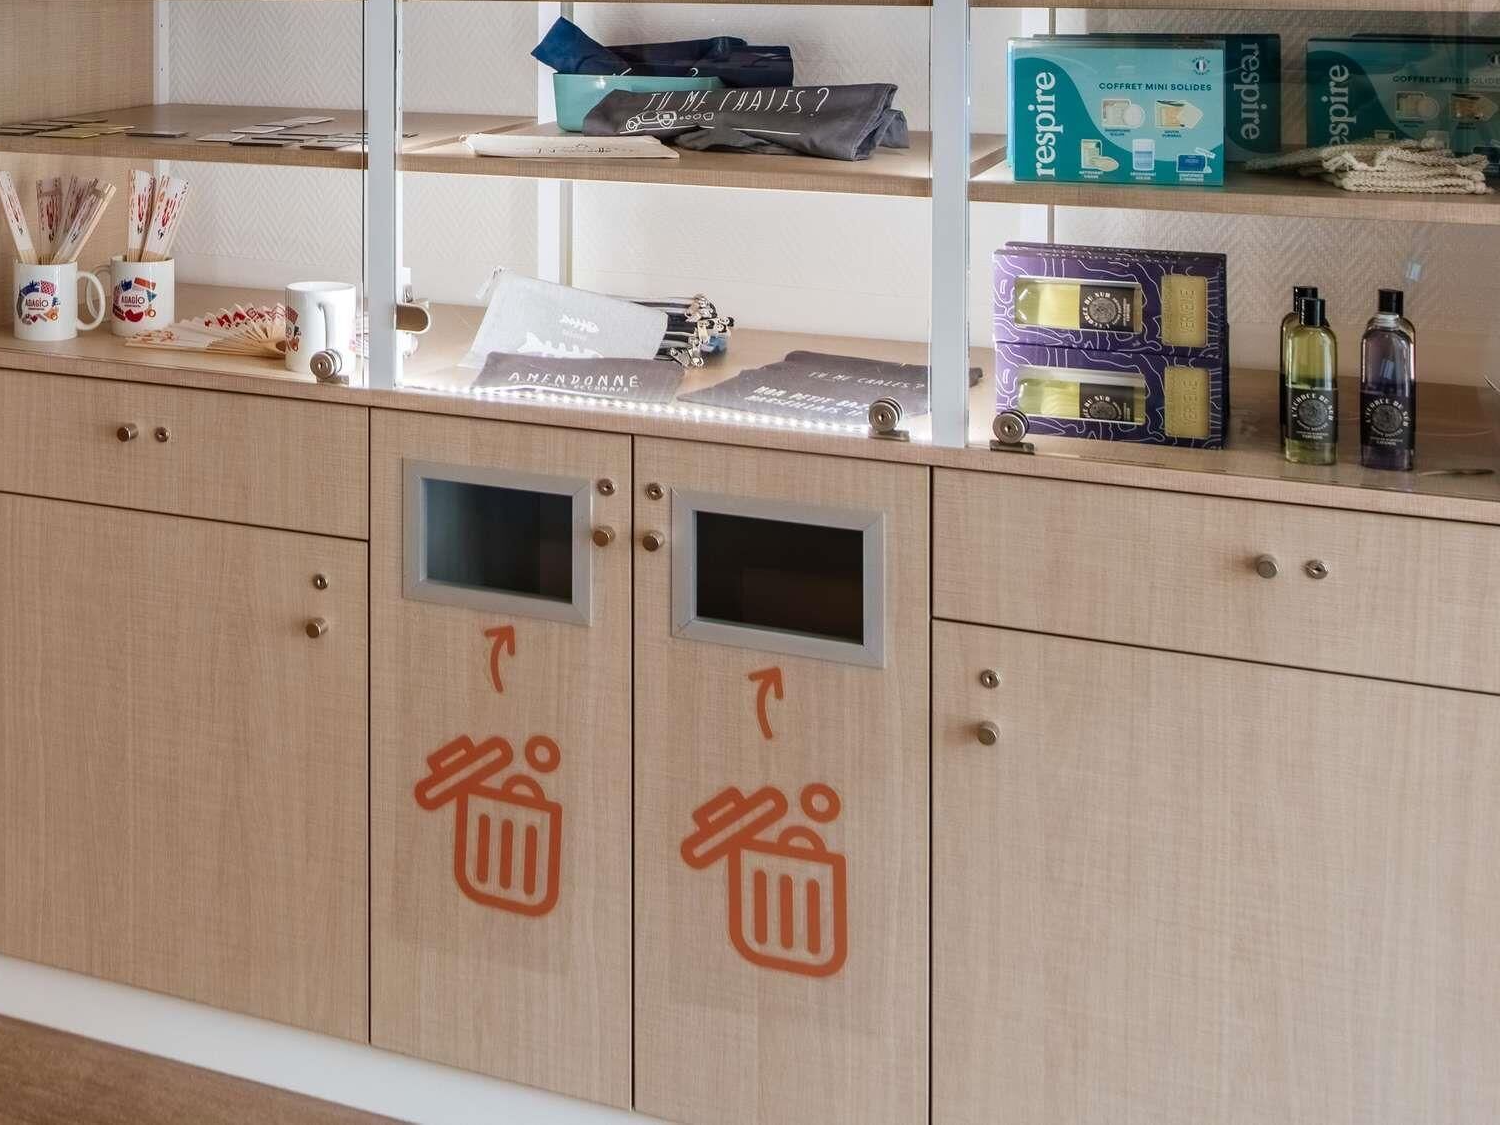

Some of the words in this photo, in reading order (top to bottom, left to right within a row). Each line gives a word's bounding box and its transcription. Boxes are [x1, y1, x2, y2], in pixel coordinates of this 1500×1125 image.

[680, 89, 713, 112] ME
[1099, 83, 1143, 91] COFFRET
[1146, 83, 1168, 91] MINI
[1170, 83, 1212, 92] SOLIDES
[1233, 42, 1268, 141] respire
[1028, 71, 1063, 177] respire
